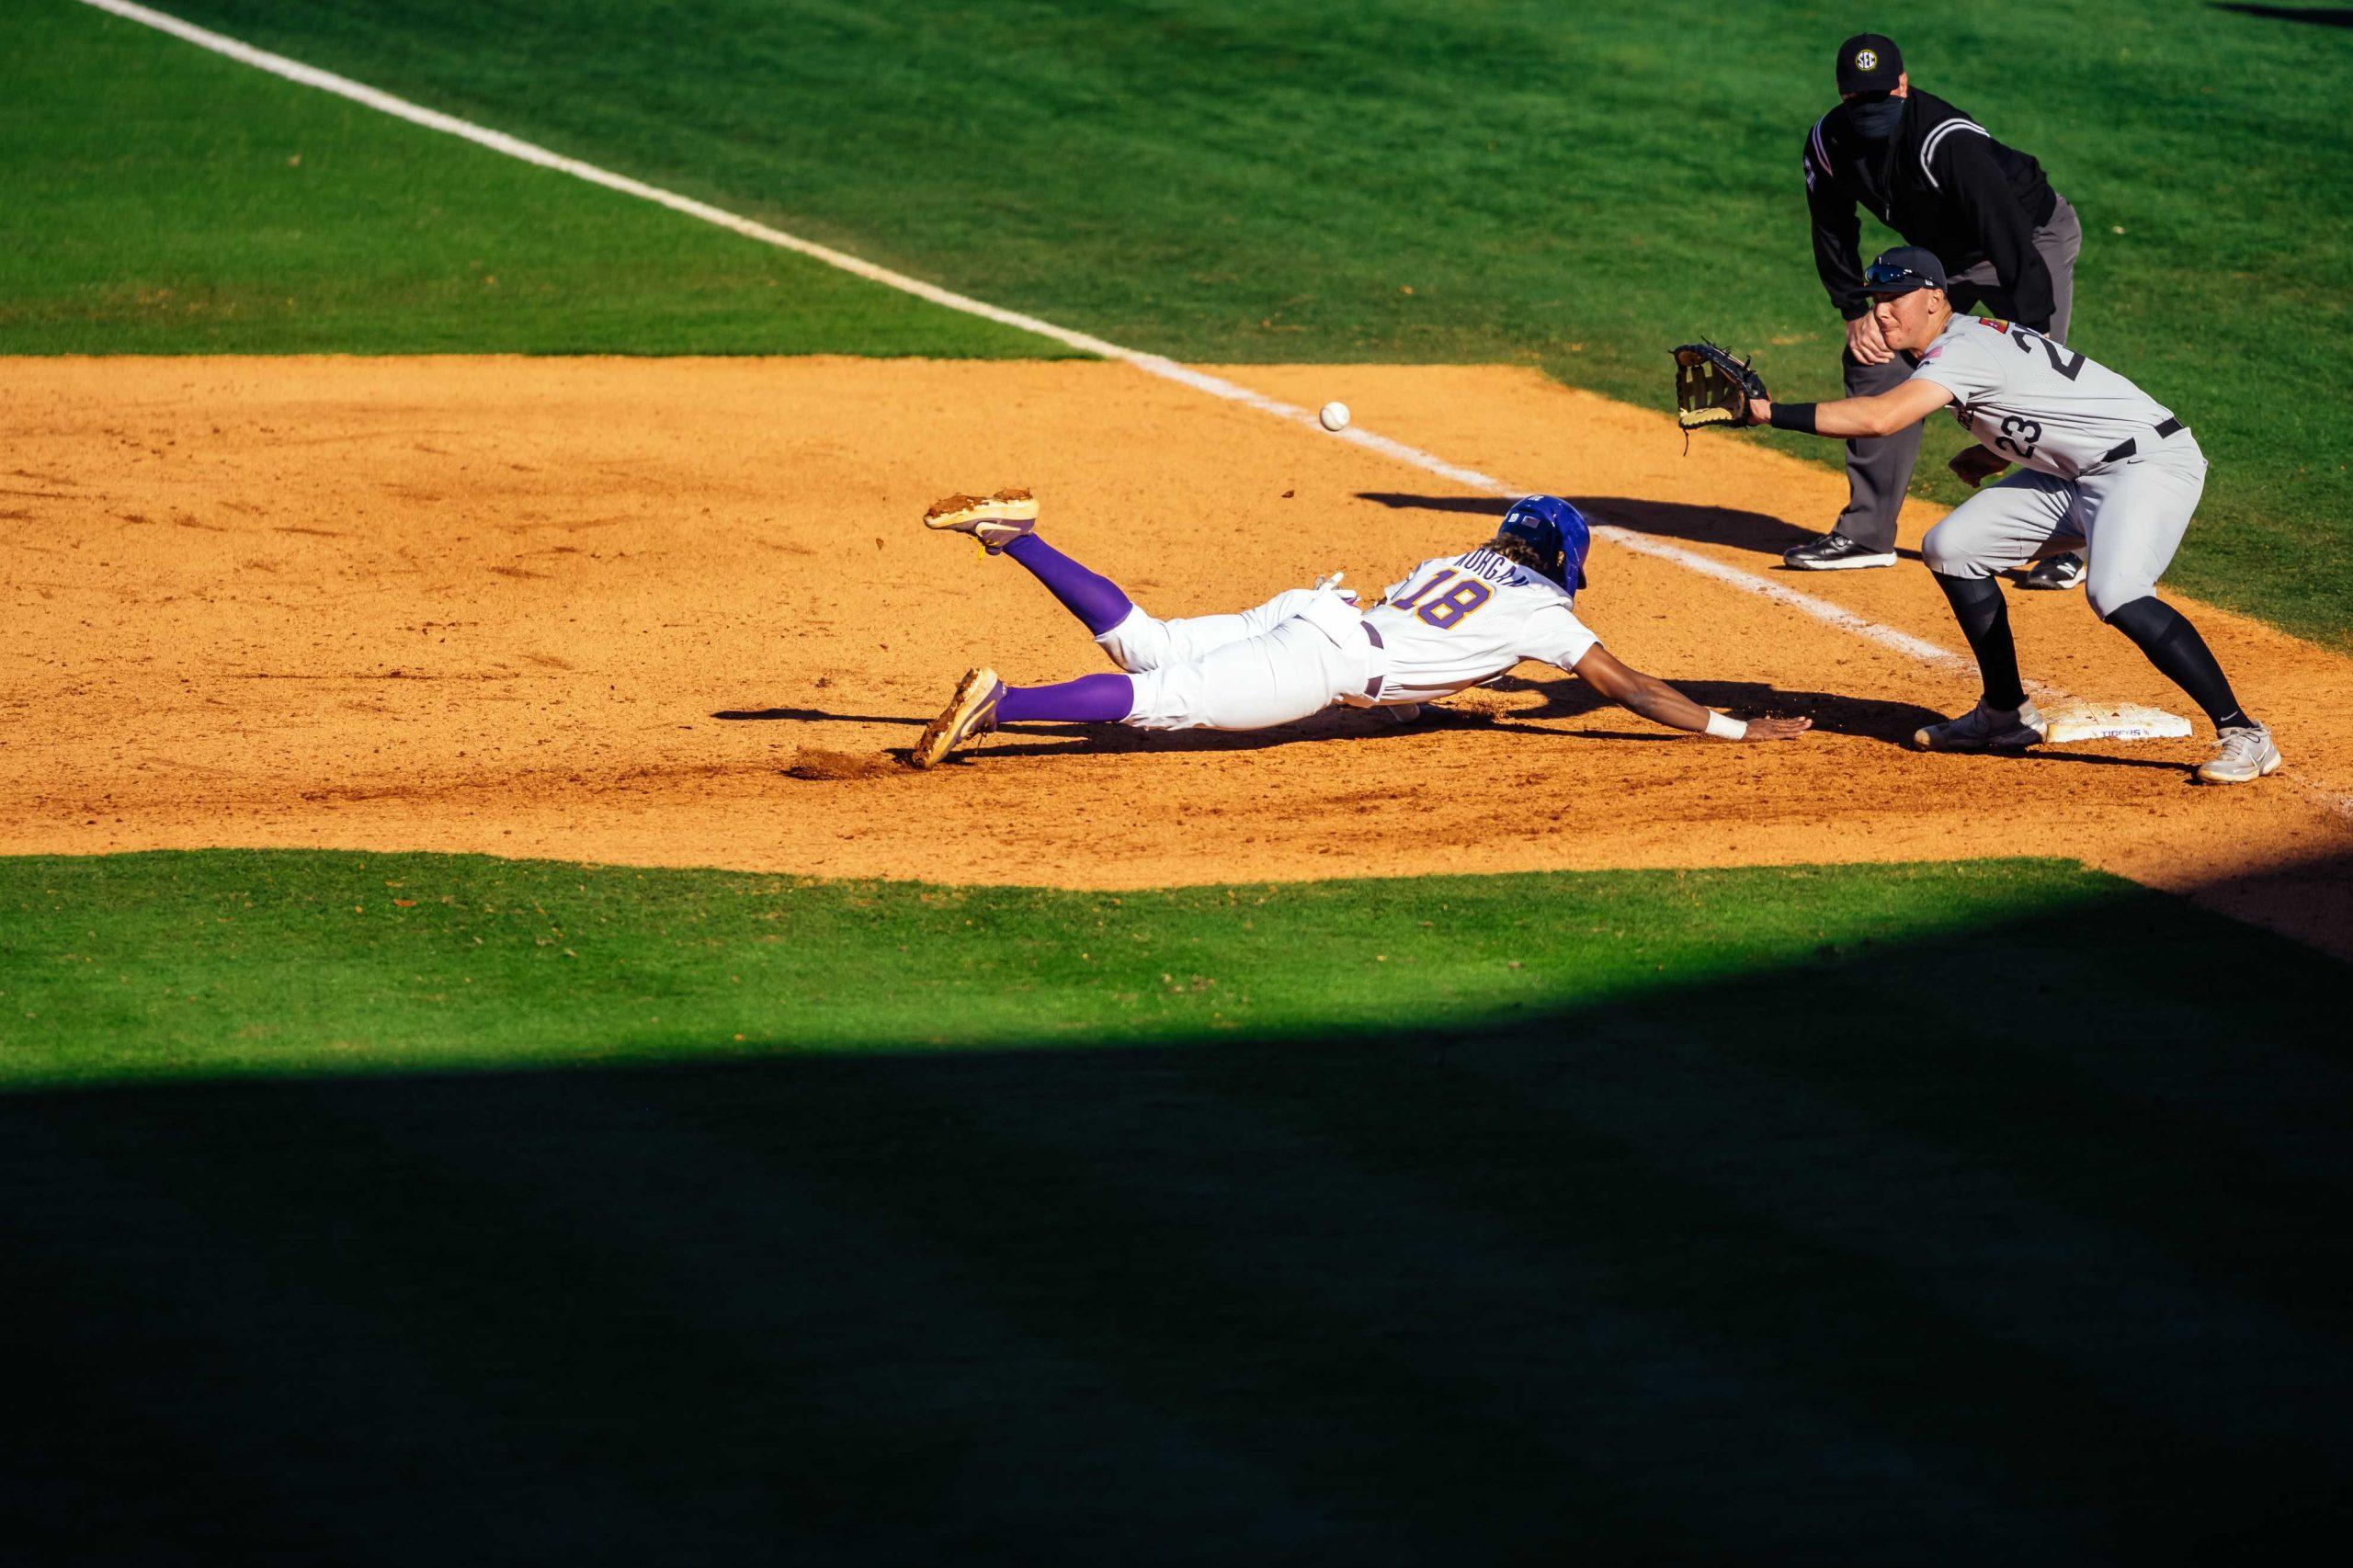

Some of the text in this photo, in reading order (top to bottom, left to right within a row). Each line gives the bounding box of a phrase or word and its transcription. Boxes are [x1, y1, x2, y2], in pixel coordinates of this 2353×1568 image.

[1858, 51, 1875, 69] SEC
[2011, 324, 2086, 381] 2
[1995, 415, 2042, 459] 23
[1389, 567, 1494, 631] 18
